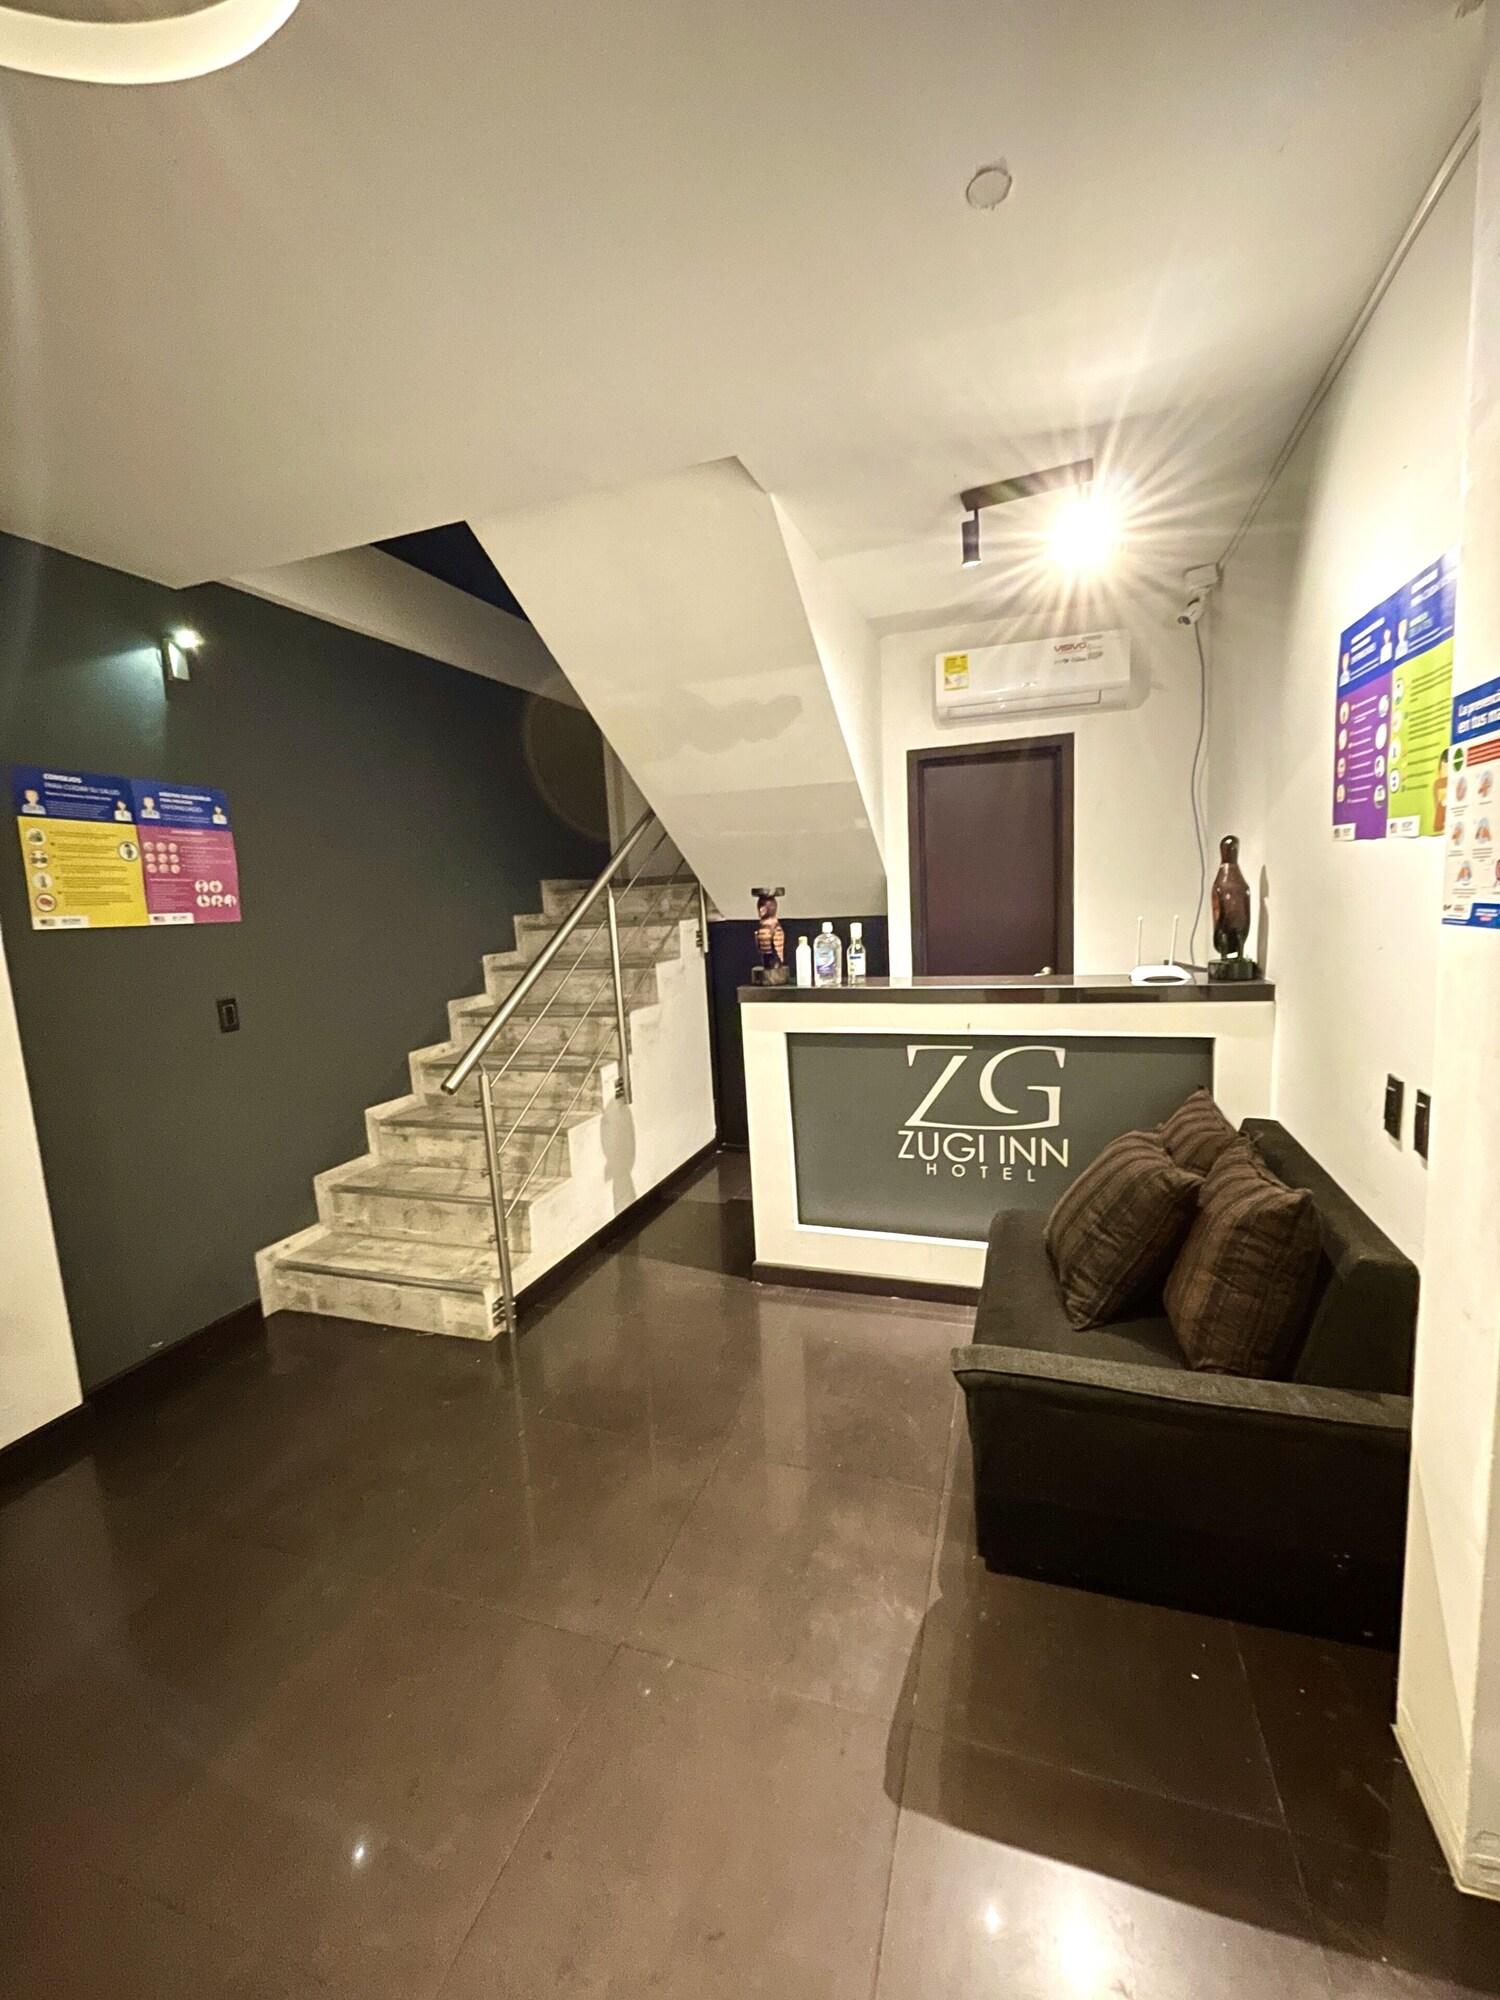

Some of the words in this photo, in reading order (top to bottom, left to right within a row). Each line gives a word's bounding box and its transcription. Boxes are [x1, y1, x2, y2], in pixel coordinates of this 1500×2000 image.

[904, 1045, 1066, 1131] ZG
[897, 1130, 985, 1163] ZUGI
[999, 1135, 1069, 1168] INN
[926, 1162, 1036, 1183] HOTEL
